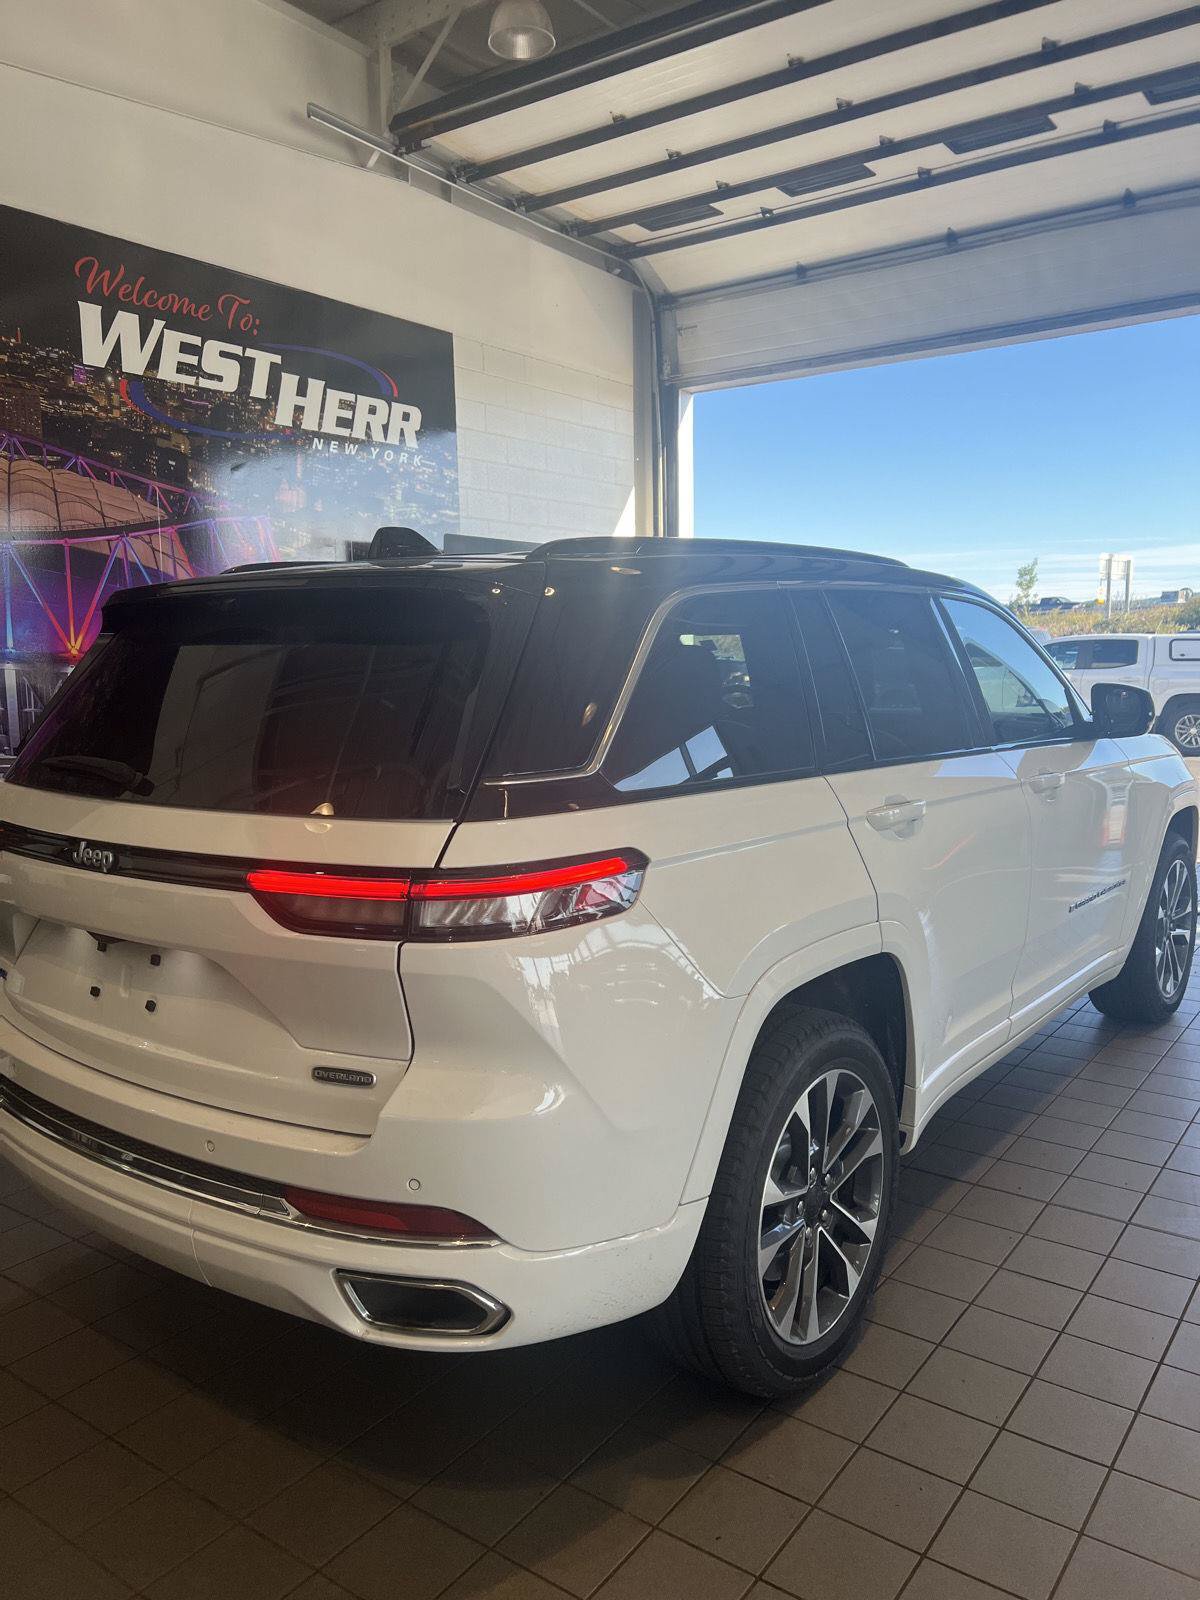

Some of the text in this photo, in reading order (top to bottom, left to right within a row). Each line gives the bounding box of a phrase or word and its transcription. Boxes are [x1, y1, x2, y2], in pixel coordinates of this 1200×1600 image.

[74, 256, 260, 336] Welcome To:
[78, 300, 422, 448] WEST HERR
[312, 437, 422, 467] NEW YORK
[72, 841, 113, 873] Jeep
